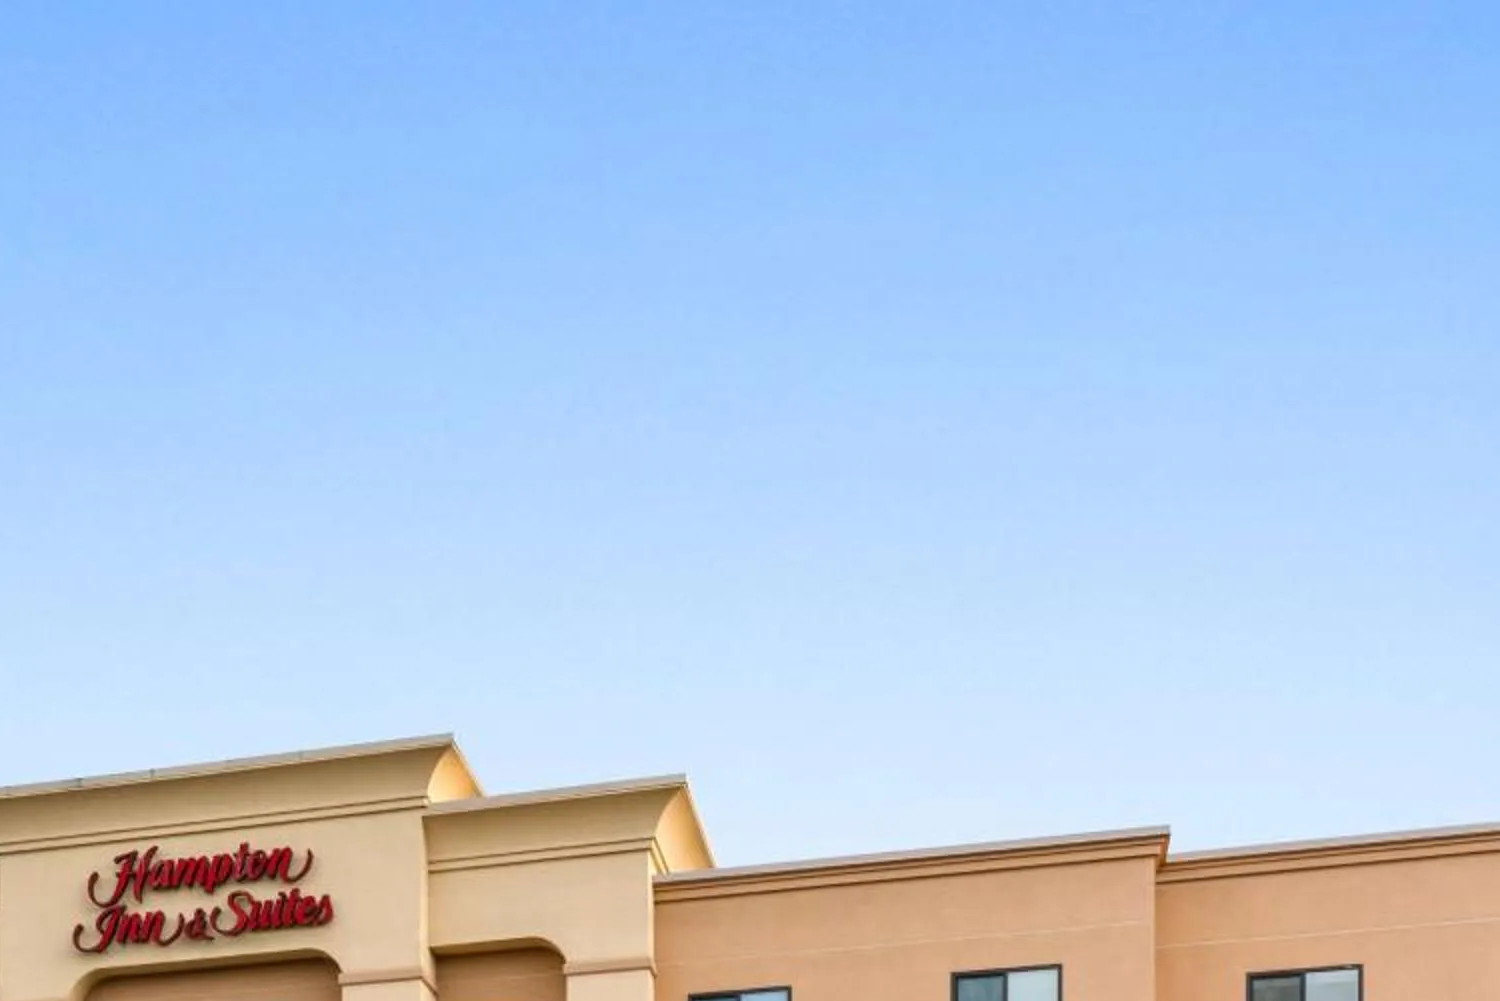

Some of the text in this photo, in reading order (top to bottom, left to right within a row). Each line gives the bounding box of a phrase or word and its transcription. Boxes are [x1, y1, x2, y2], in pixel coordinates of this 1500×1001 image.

[88, 842, 314, 907] Hampton
[73, 888, 334, 953] Inn & Suites
